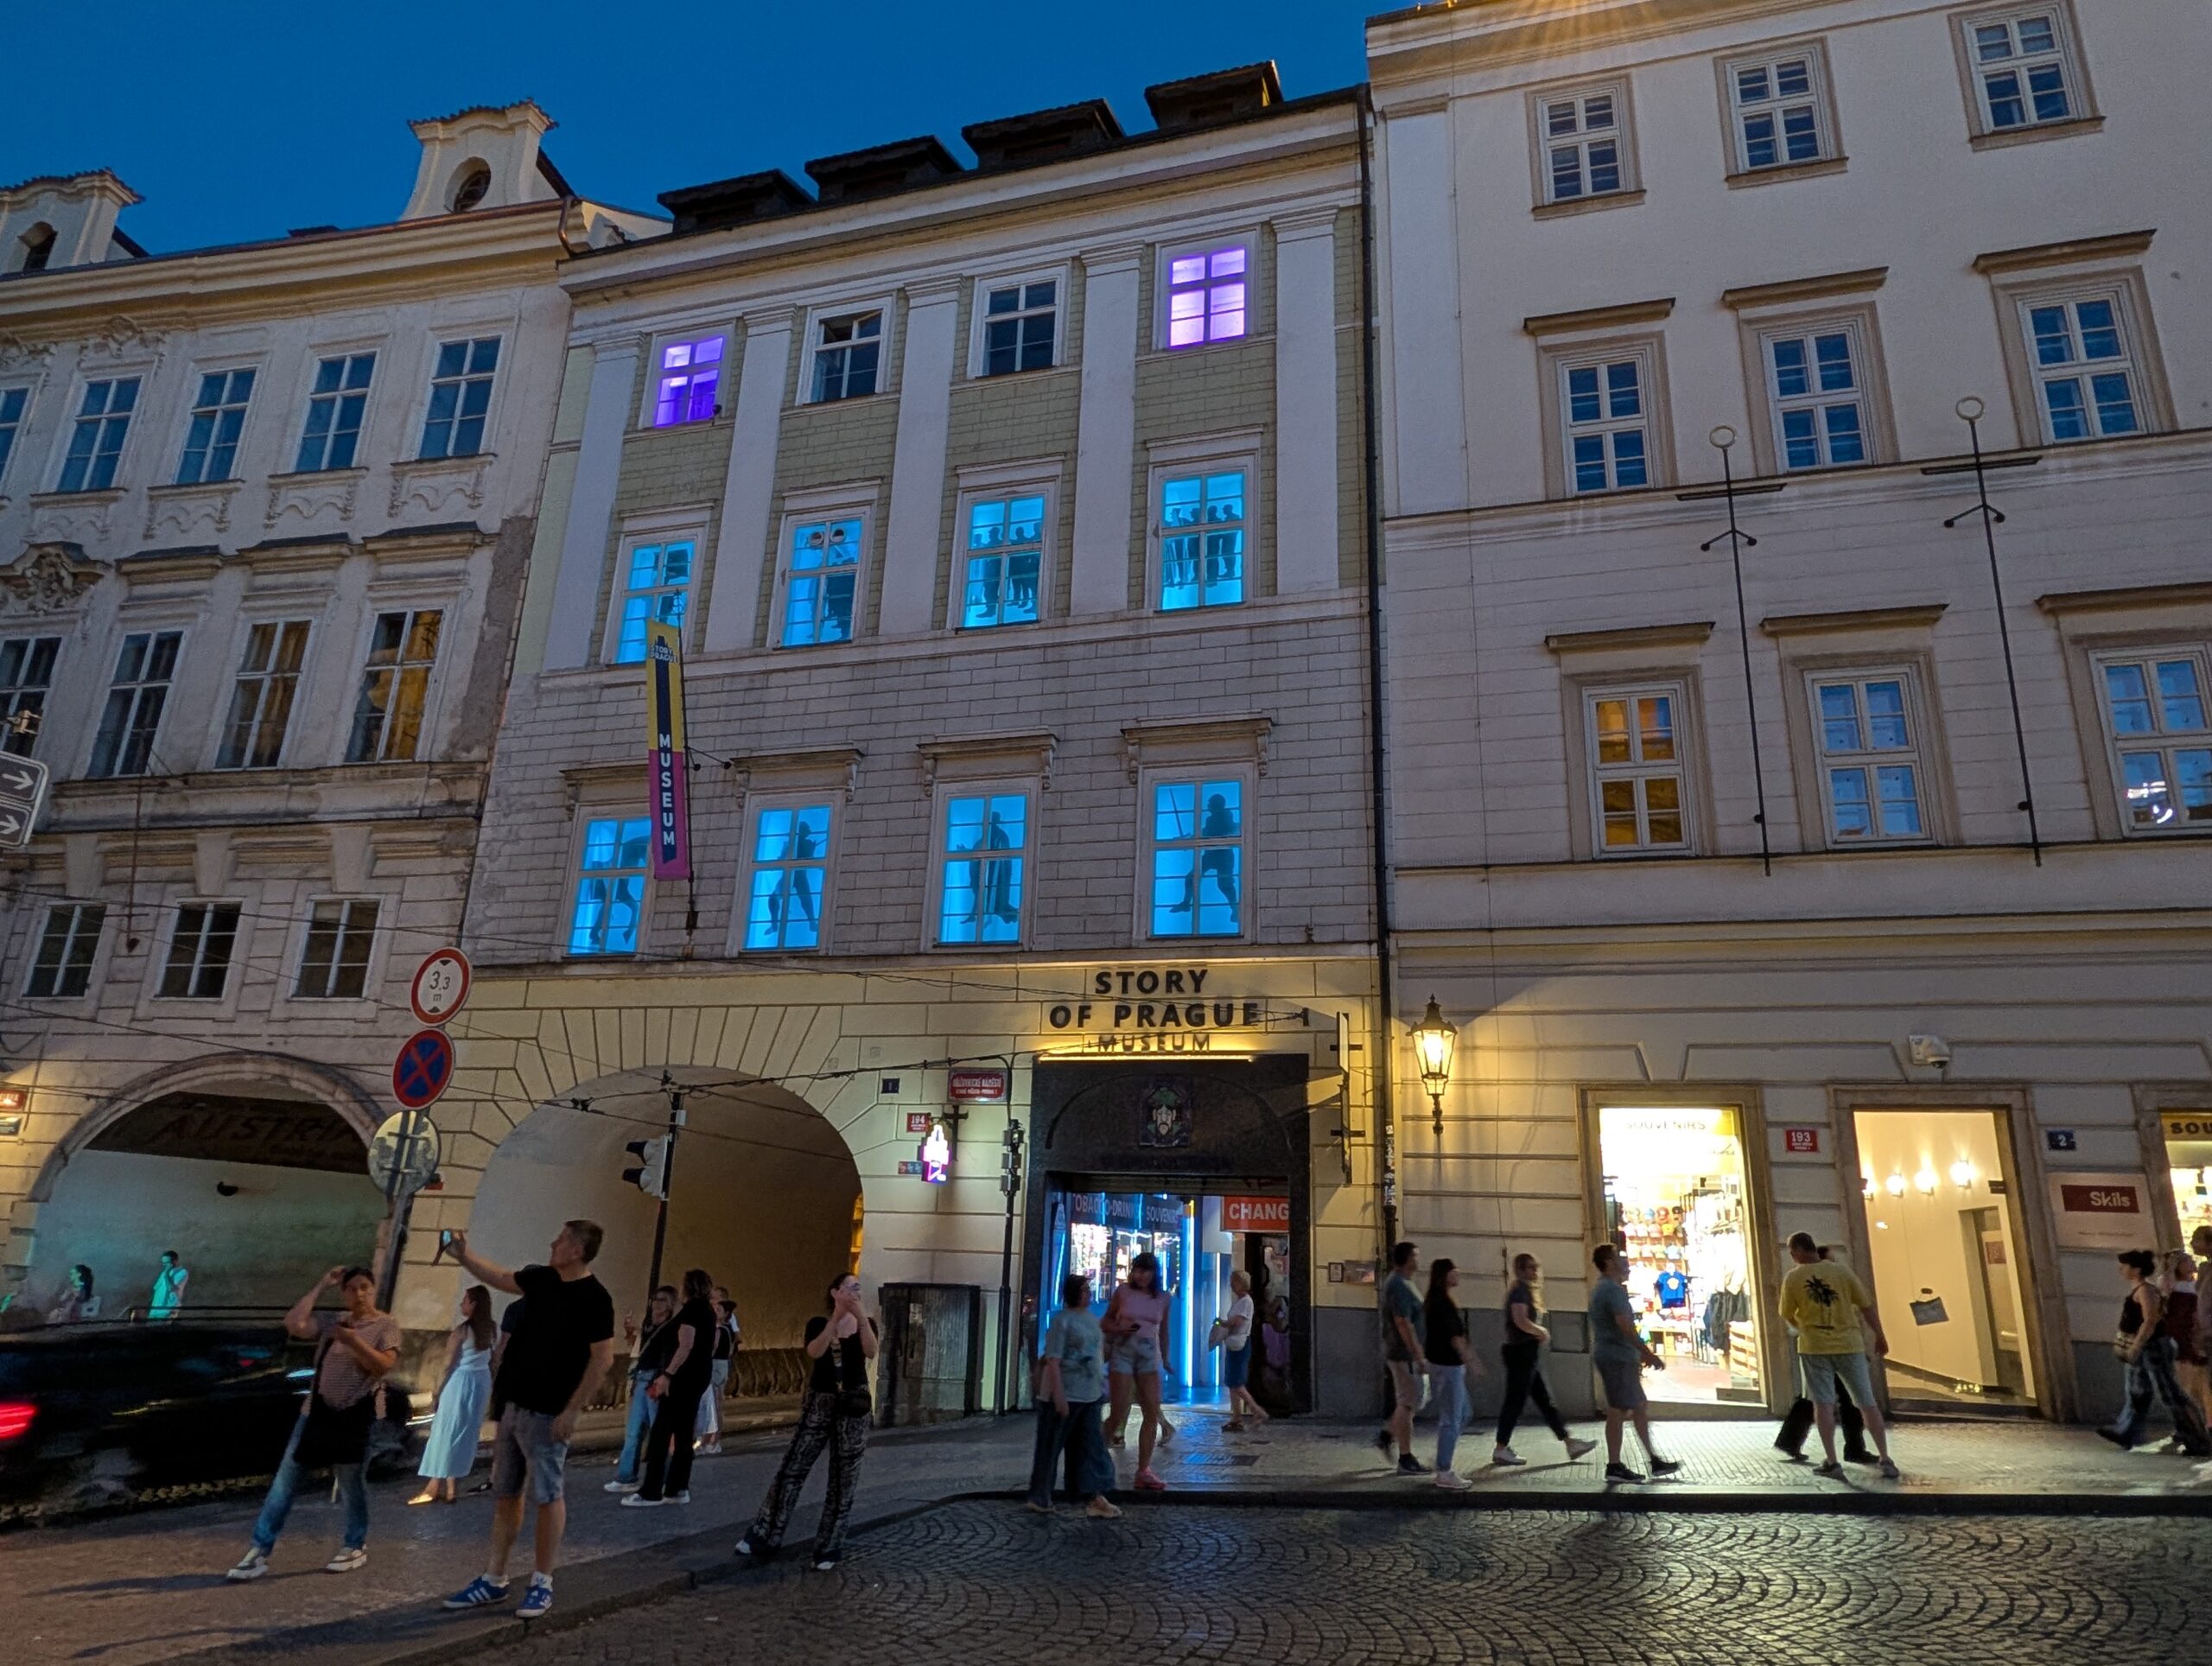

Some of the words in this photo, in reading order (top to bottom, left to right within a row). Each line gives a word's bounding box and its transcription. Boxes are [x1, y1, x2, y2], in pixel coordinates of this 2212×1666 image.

[659, 734, 675, 845] MUSEUM
[429, 970, 450, 990] 3.3
[1095, 969, 1208, 995] STORY
[1049, 1005, 1092, 1028] OF
[1113, 1002, 1258, 1028] PRAGUE
[1098, 1033, 1210, 1052] MUSEUM
[911, 1115, 925, 1124] 194
[1791, 1131, 1811, 1142] 193
[2058, 1135, 2067, 1146] 2
[2089, 1192, 2131, 1207] Skils
[1229, 1203, 1290, 1220] CHANG
